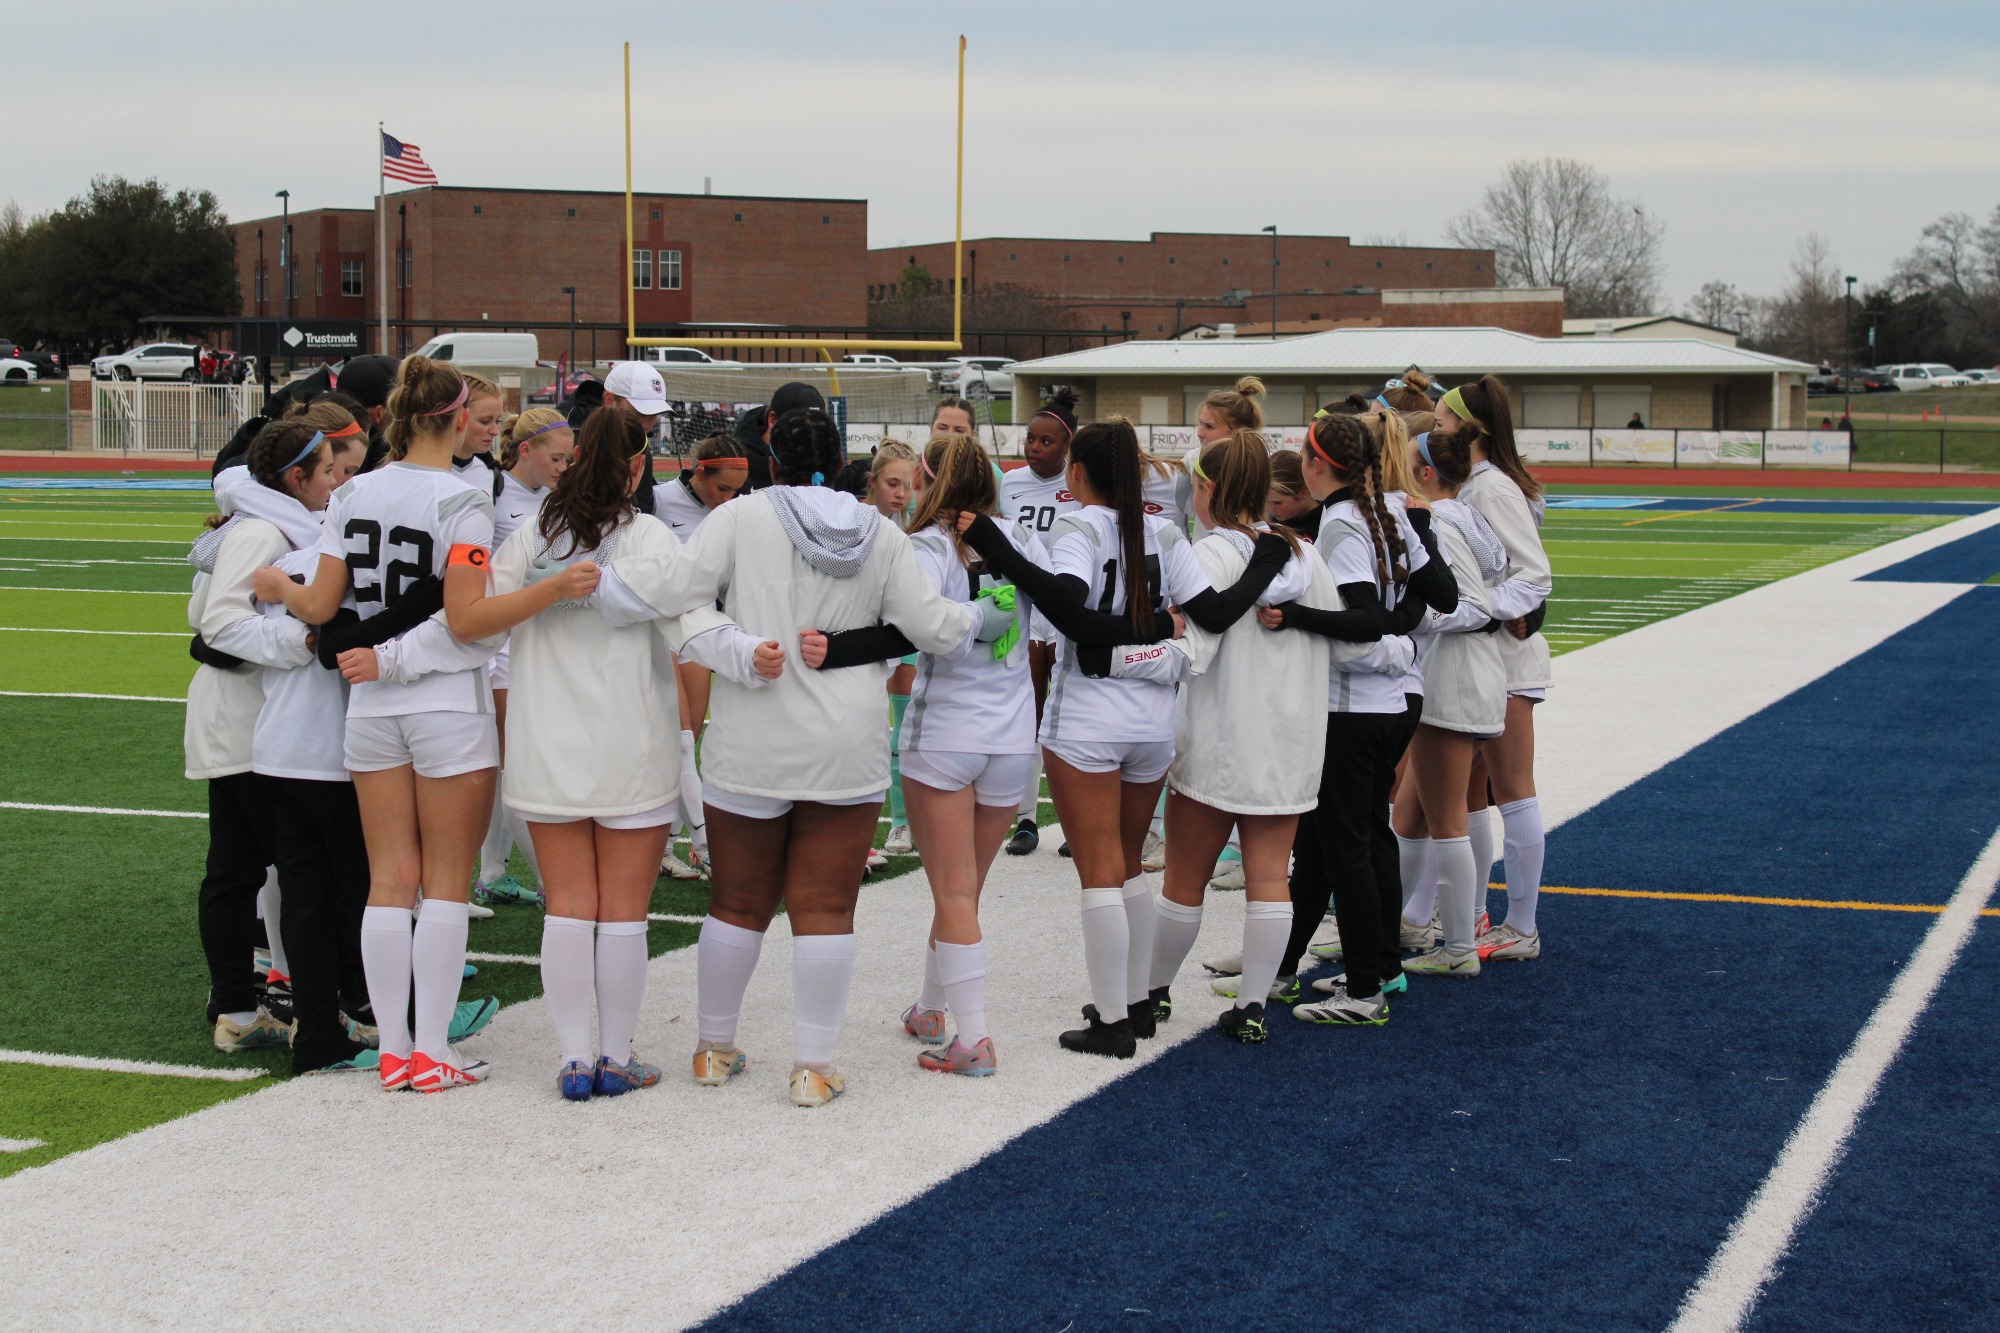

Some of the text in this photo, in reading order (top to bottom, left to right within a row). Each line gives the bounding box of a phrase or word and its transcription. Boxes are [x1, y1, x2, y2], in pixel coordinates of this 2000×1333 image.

[305, 332, 357, 343] Trustmark
[1152, 432, 1192, 446] FRIDAY
[1018, 505, 1056, 532] 20
[344, 518, 434, 609] 22
[468, 548, 485, 566] C
[1124, 646, 1167, 664] JONES
